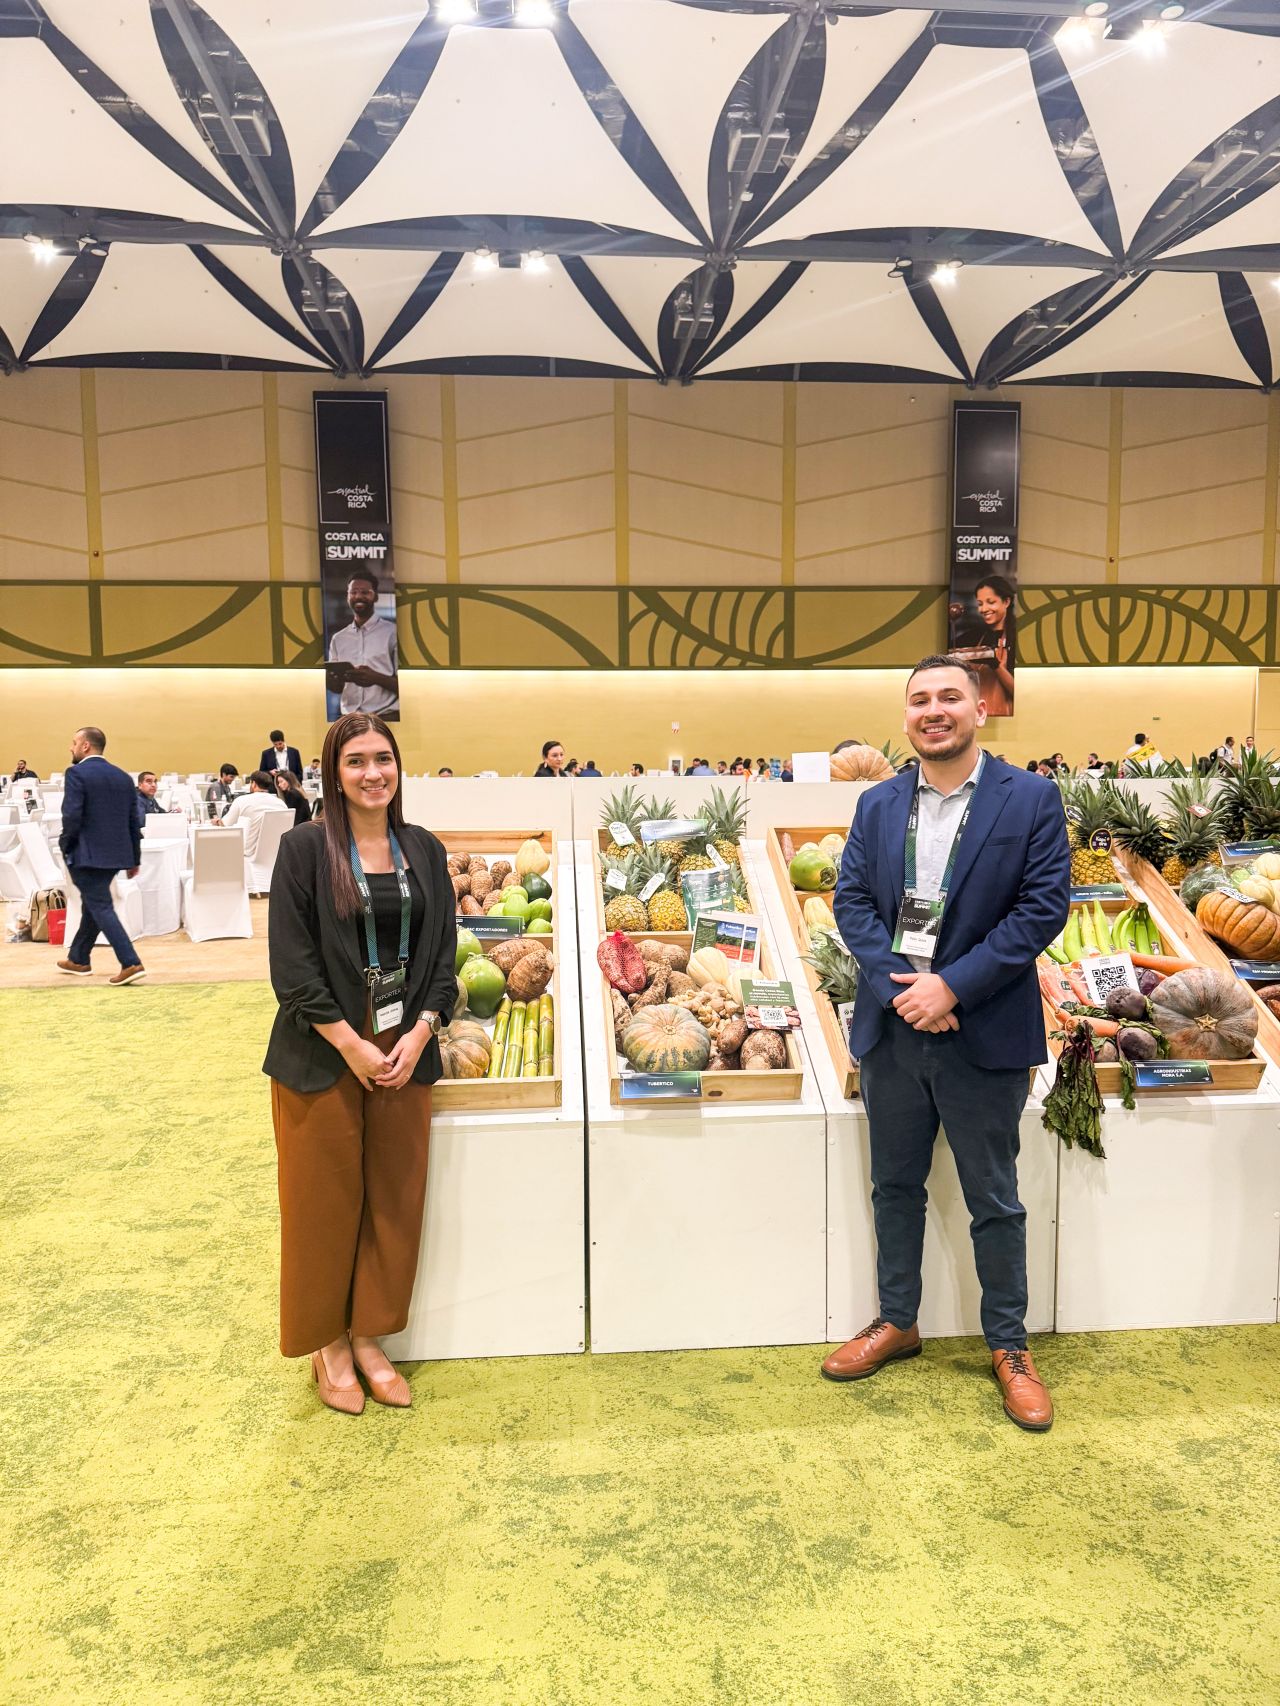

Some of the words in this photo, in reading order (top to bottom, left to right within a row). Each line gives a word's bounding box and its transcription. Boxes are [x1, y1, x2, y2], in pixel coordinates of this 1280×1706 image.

[327, 484, 376, 496] essential
[961, 489, 1007, 501] essential
[347, 495, 373, 503] COSTA
[325, 532, 359, 541] COSTA
[360, 532, 384, 541] RICA
[957, 535, 988, 544] COSTA
[989, 535, 1010, 544] RICA
[327, 546, 387, 559] SUMMIT
[957, 548, 1012, 561] SUMMIT
[375, 988, 402, 1003] EXPORTER
